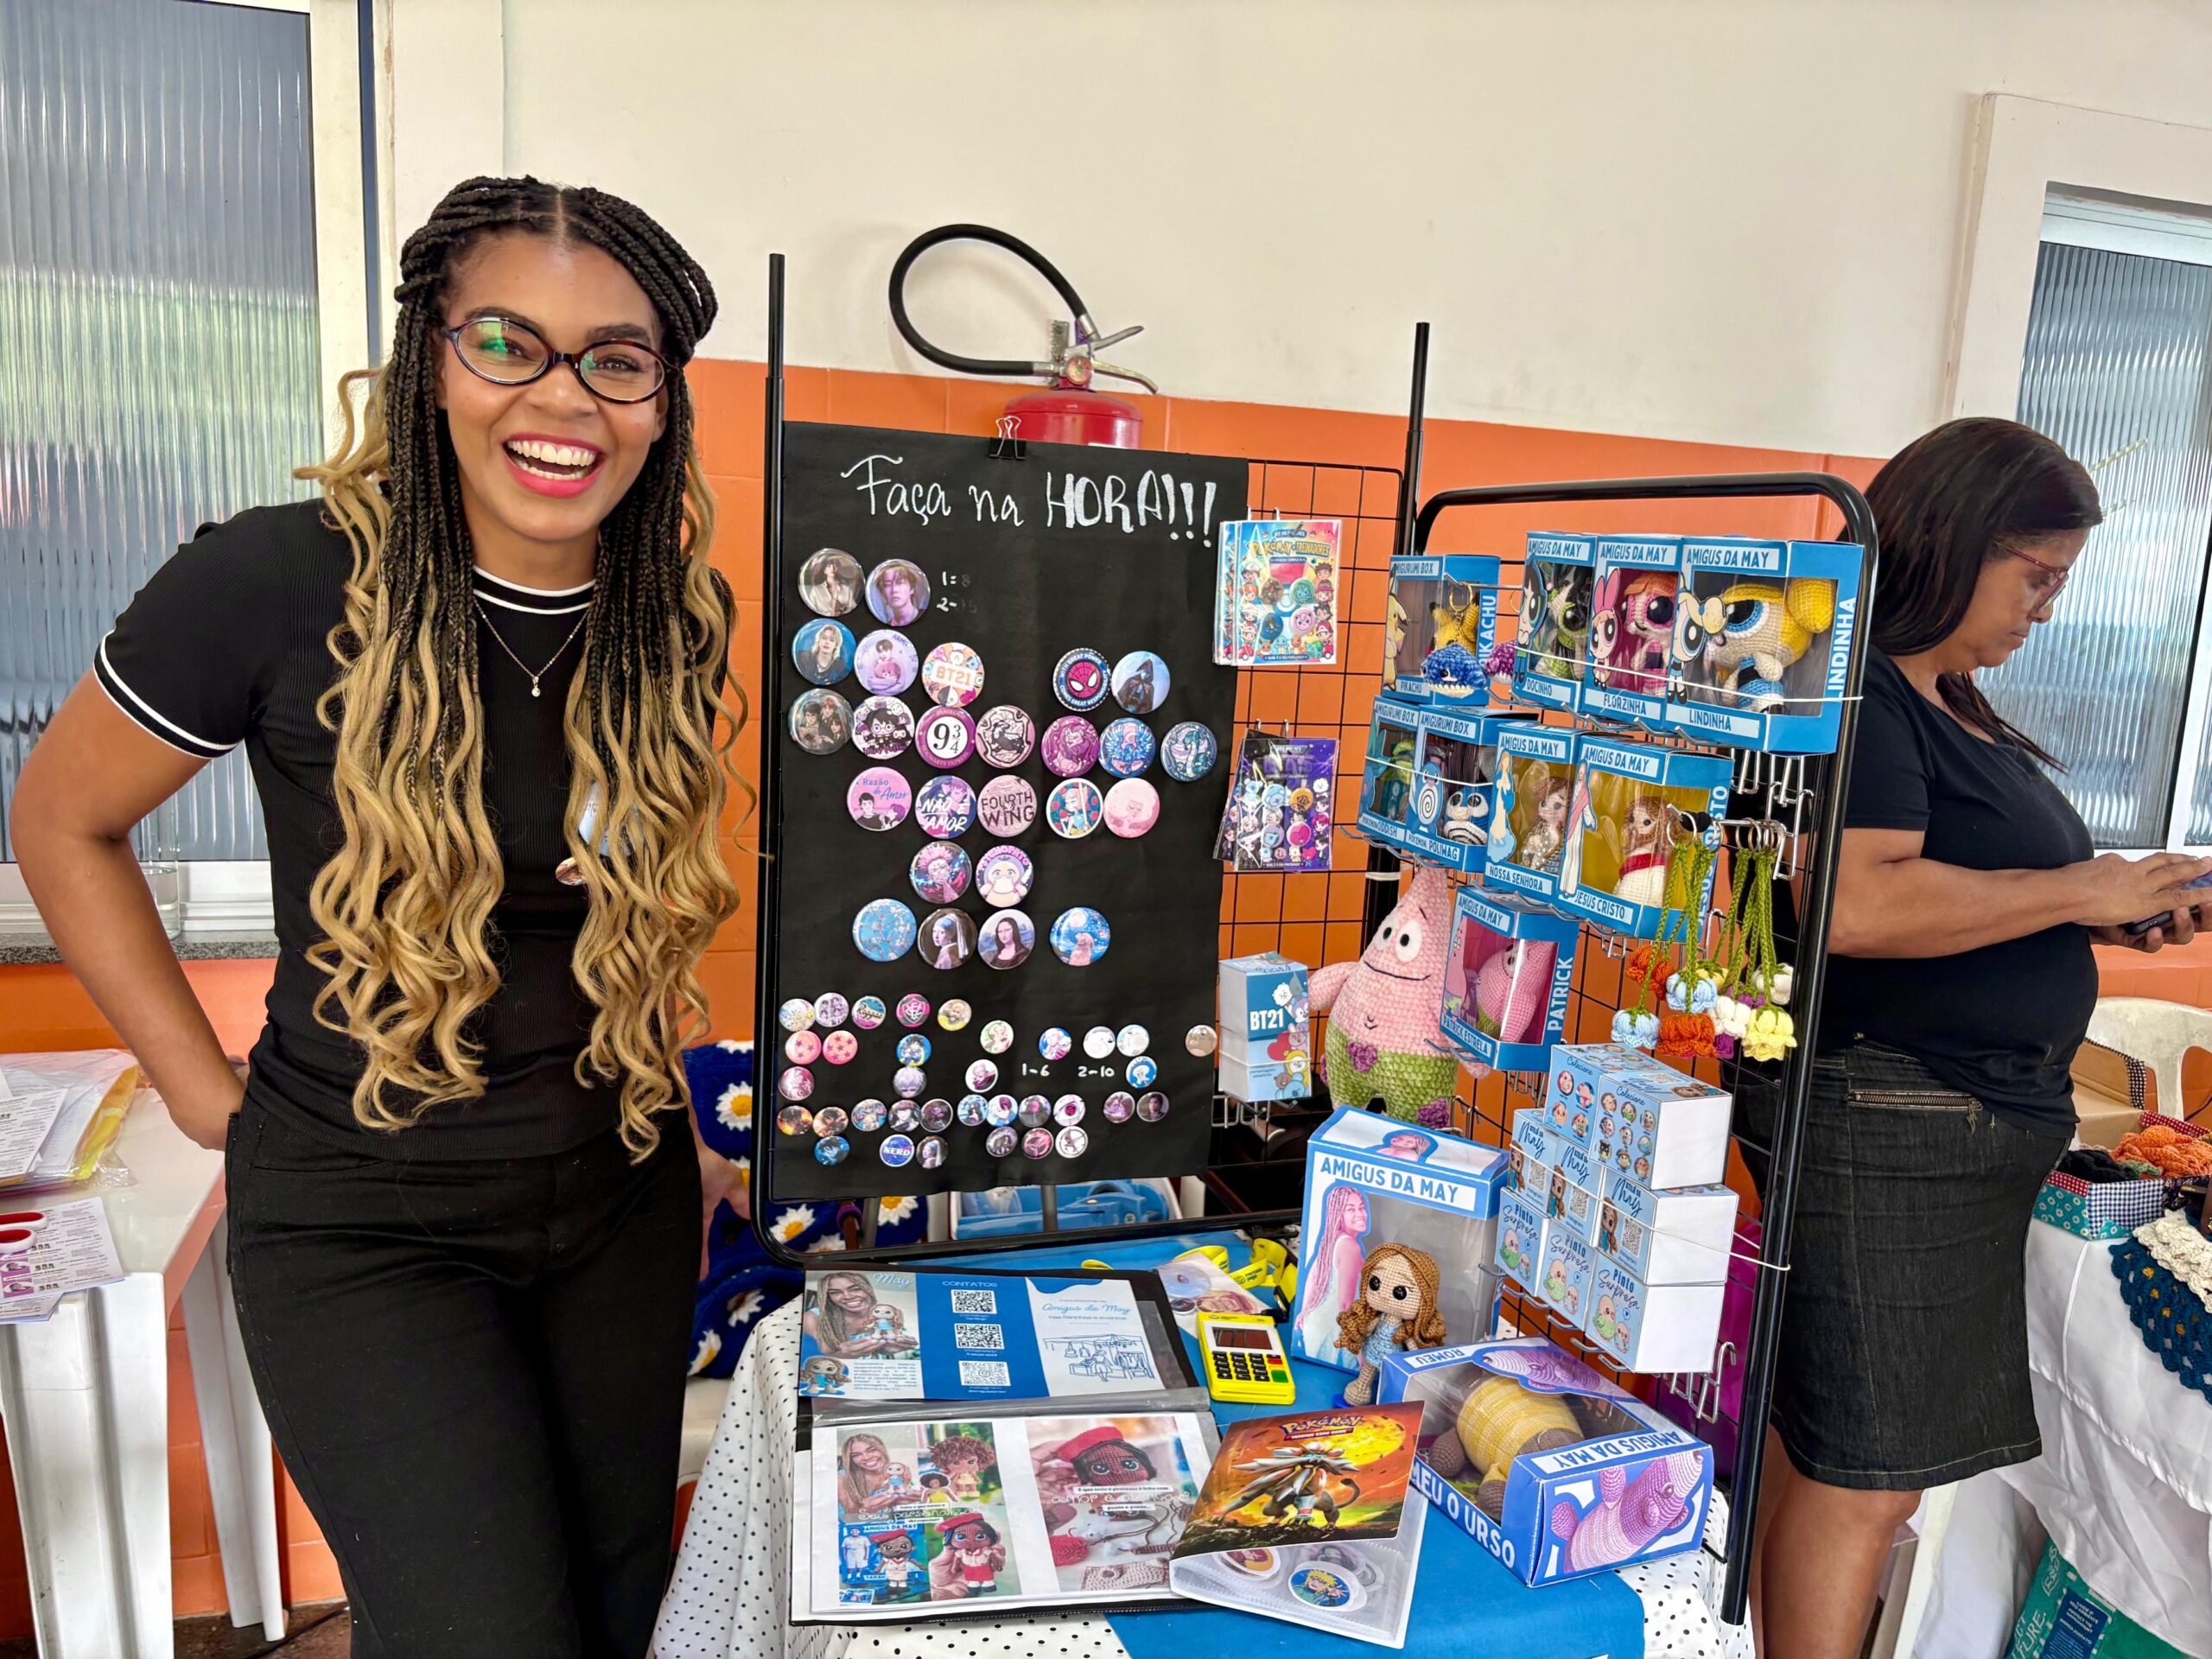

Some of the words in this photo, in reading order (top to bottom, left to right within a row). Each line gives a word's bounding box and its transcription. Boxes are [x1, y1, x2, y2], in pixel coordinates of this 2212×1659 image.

[841, 454, 950, 525] Faça
[969, 486, 1025, 526] na
[1046, 470, 1217, 548] HORA!!!
[1529, 540, 1551, 553] AMIGUS
[1553, 543, 1562, 555] DA
[1563, 543, 1581, 557] MAY
[1600, 544, 1630, 560] AMIGUS
[1632, 546, 1643, 561] DA
[1645, 546, 1668, 562] MAY
[1687, 549, 1721, 565] AMIGUS
[1724, 550, 1738, 566] DA
[1741, 550, 1769, 568] MAY
[1421, 563, 1433, 575] BOX
[1069, 653, 1084, 664] GREAT
[1084, 652, 1102, 664] POWER
[935, 664, 972, 685] BT21
[1059, 685, 1071, 701] COMES
[1071, 698, 1086, 707] GREAT
[1401, 681, 1422, 694] PIKACHU
[1527, 678, 1553, 696] DOCINHO
[1604, 693, 1646, 715] FLORZINHA
[1402, 710, 1414, 723] BOX
[1421, 714, 1452, 729] AMIGURUMI
[1453, 721, 1469, 735] BOX
[1689, 709, 1732, 731] LINDINHA
[933, 723, 950, 750] 9
[1500, 735, 1527, 751] AMIGUS
[1529, 741, 1539, 753] DA
[1541, 742, 1559, 757] MAY
[1584, 747, 1613, 765] AMIGUS
[1615, 753, 1626, 767] DA
[1628, 756, 1649, 772] MAY
[880, 787, 908, 800] Amor
[922, 794, 950, 812] NÃO
[982, 791, 1033, 810] FOURTH
[925, 816, 967, 832] AMOR
[982, 804, 1035, 827] WING
[1378, 820, 1397, 838] ODDISH
[1408, 834, 1427, 848] POKEMON
[1429, 841, 1458, 861] POLIWAG
[1489, 866, 1510, 881] NOSSA
[1512, 872, 1542, 892] SENHORA
[1458, 895, 1478, 916] AMIGUS
[1478, 906, 1487, 919] DA
[1487, 909, 1503, 926] MAY
[1575, 891, 1596, 910] JESUS
[1597, 899, 1625, 919] CRISTO
[1548, 957, 1573, 1031] PATRICK
[1249, 1007, 1284, 1031] BT21
[1443, 1014, 1464, 1036] PATRICK
[1465, 1030, 1488, 1055] ESTRELA
[1567, 1056, 1594, 1076] Colecione
[1616, 1085, 1646, 1106] Colecione
[883, 1146, 911, 1156] NERD
[1518, 1122, 1546, 1160] May
[1561, 1146, 1590, 1185] May
[1320, 1157, 1385, 1186] AMIGUS
[1391, 1170, 1416, 1194] DA
[1420, 1179, 1459, 1205] MAY
[1611, 1178, 1643, 1218] May
[1503, 1205, 1539, 1241] Surpresa
[1515, 1205, 1534, 1225] Pinto
[1550, 1235, 1590, 1274] Surpresa
[1565, 1234, 1586, 1257] Pinto
[873, 1273, 912, 1287] May
[1599, 1269, 1640, 1309] Surpresa
[1613, 1268, 1635, 1293] Pinto
[1041, 1302, 1083, 1313] Amigus
[1101, 1304, 1131, 1315] May
[1415, 1349, 1463, 1365] ROMEU
[1585, 1441, 1611, 1457] DA
[1615, 1430, 1681, 1453] AMIGUS
[1556, 1450, 1583, 1468] MAY
[1446, 1496, 1459, 1519] O
[1464, 1510, 1516, 1569] URSO
